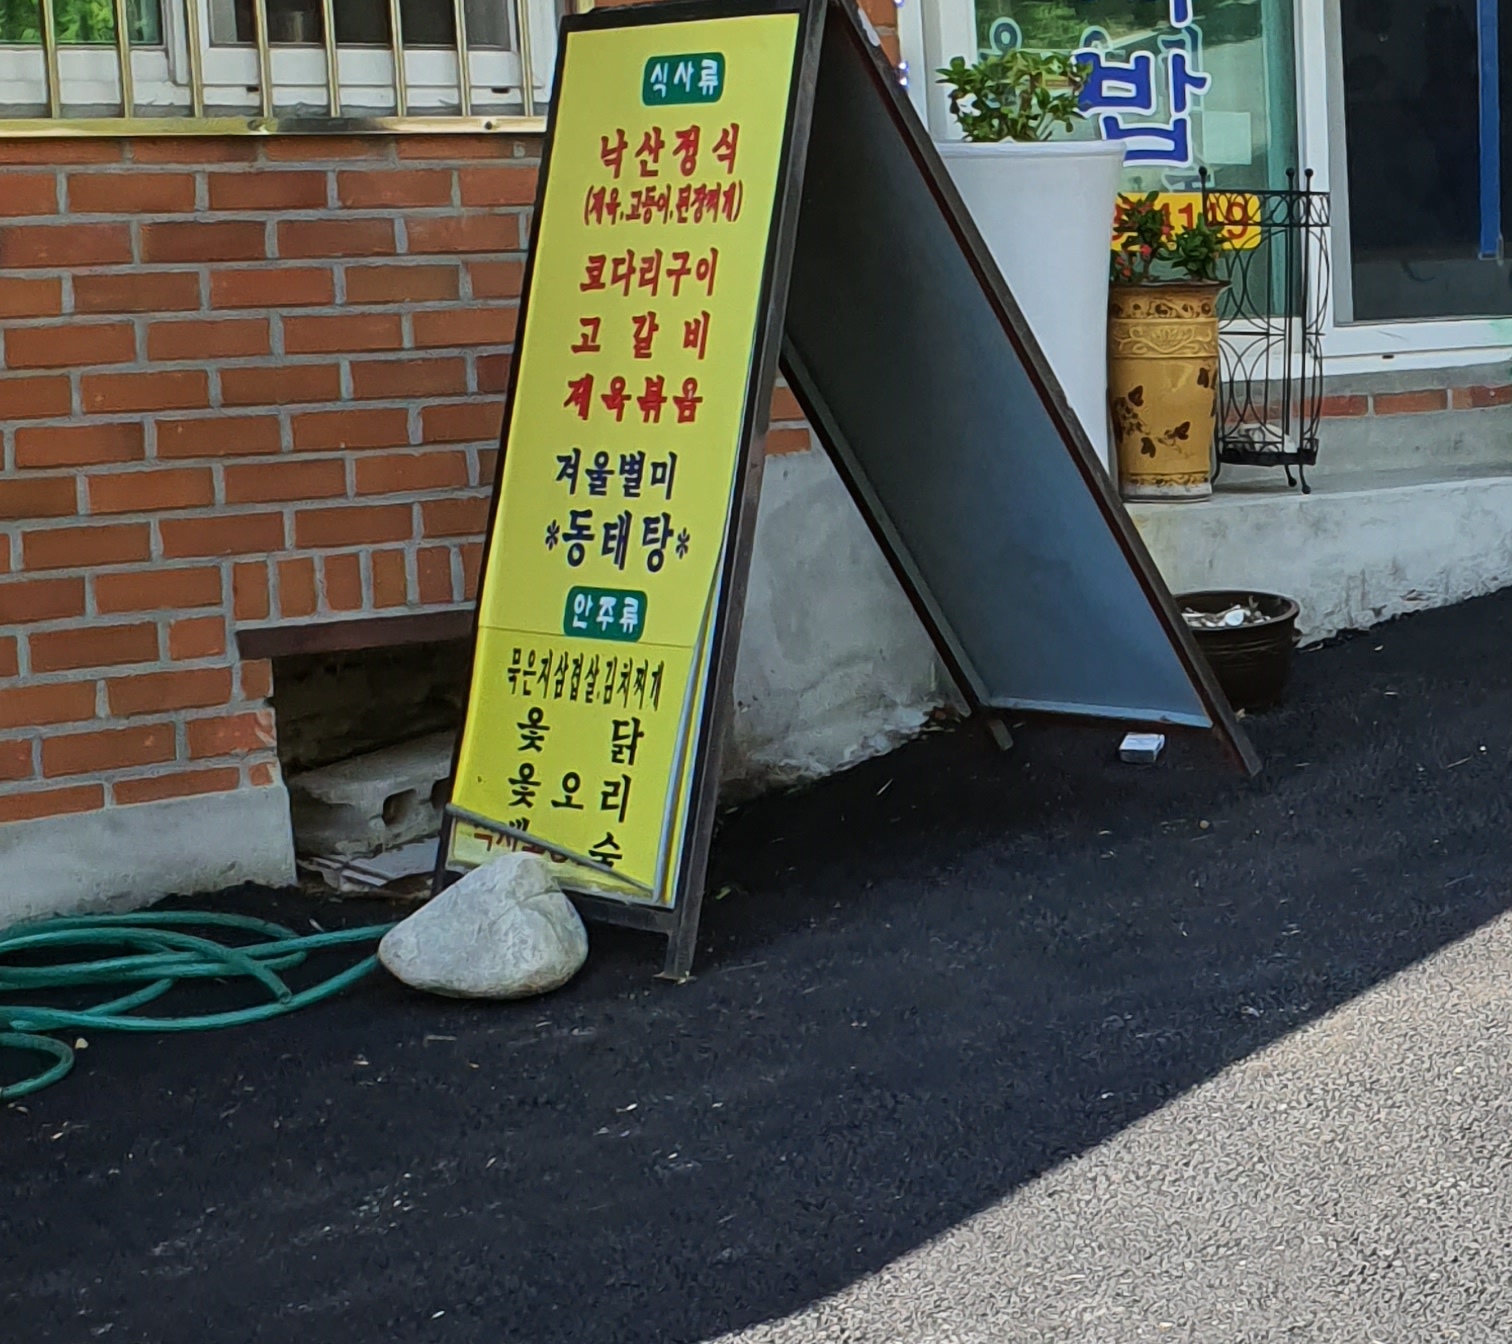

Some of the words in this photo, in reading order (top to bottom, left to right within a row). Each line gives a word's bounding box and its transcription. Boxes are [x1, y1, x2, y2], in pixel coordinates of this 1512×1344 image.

[650, 58, 719, 97] 식사류
[600, 123, 741, 178] 낙산정식
[579, 247, 719, 297] 코다리구이
[571, 311, 711, 360] 고갈비
[563, 373, 703, 423] 제육볶음
[555, 447, 678, 500] 겨울별미
[572, 593, 640, 632] 안주류
